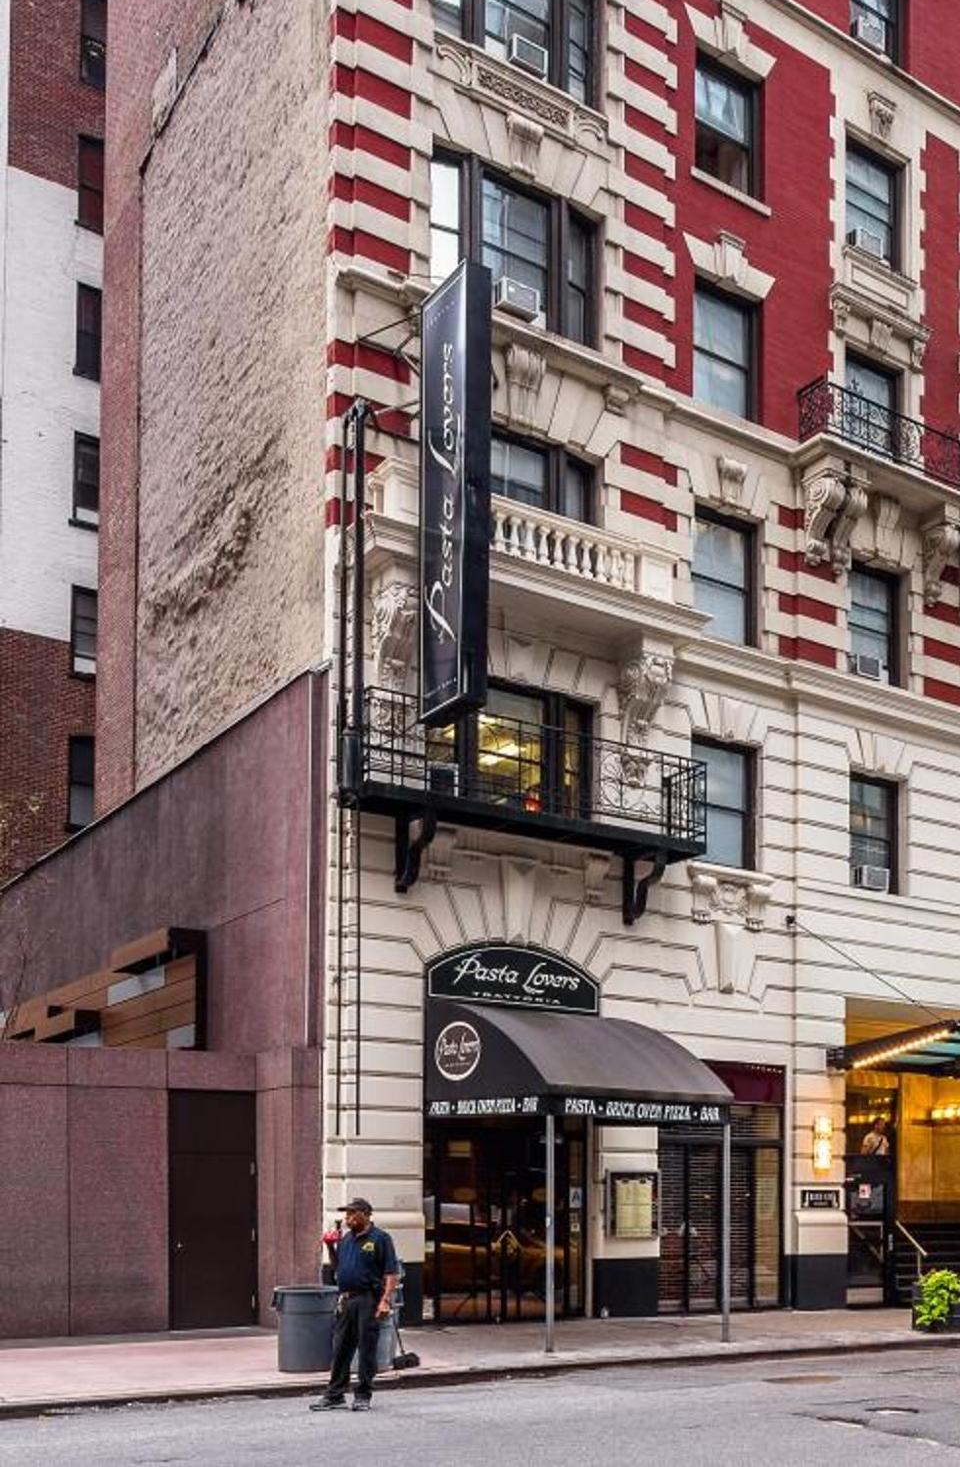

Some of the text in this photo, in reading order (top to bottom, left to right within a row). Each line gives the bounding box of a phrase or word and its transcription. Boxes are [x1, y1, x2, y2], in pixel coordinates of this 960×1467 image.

[428, 342, 462, 479] Lovers
[424, 493, 457, 645] Pasta
[453, 953, 581, 995] Pasta Lovers
[565, 1098, 721, 1121] PASTA BRICK OVEN PIZZA BAR
